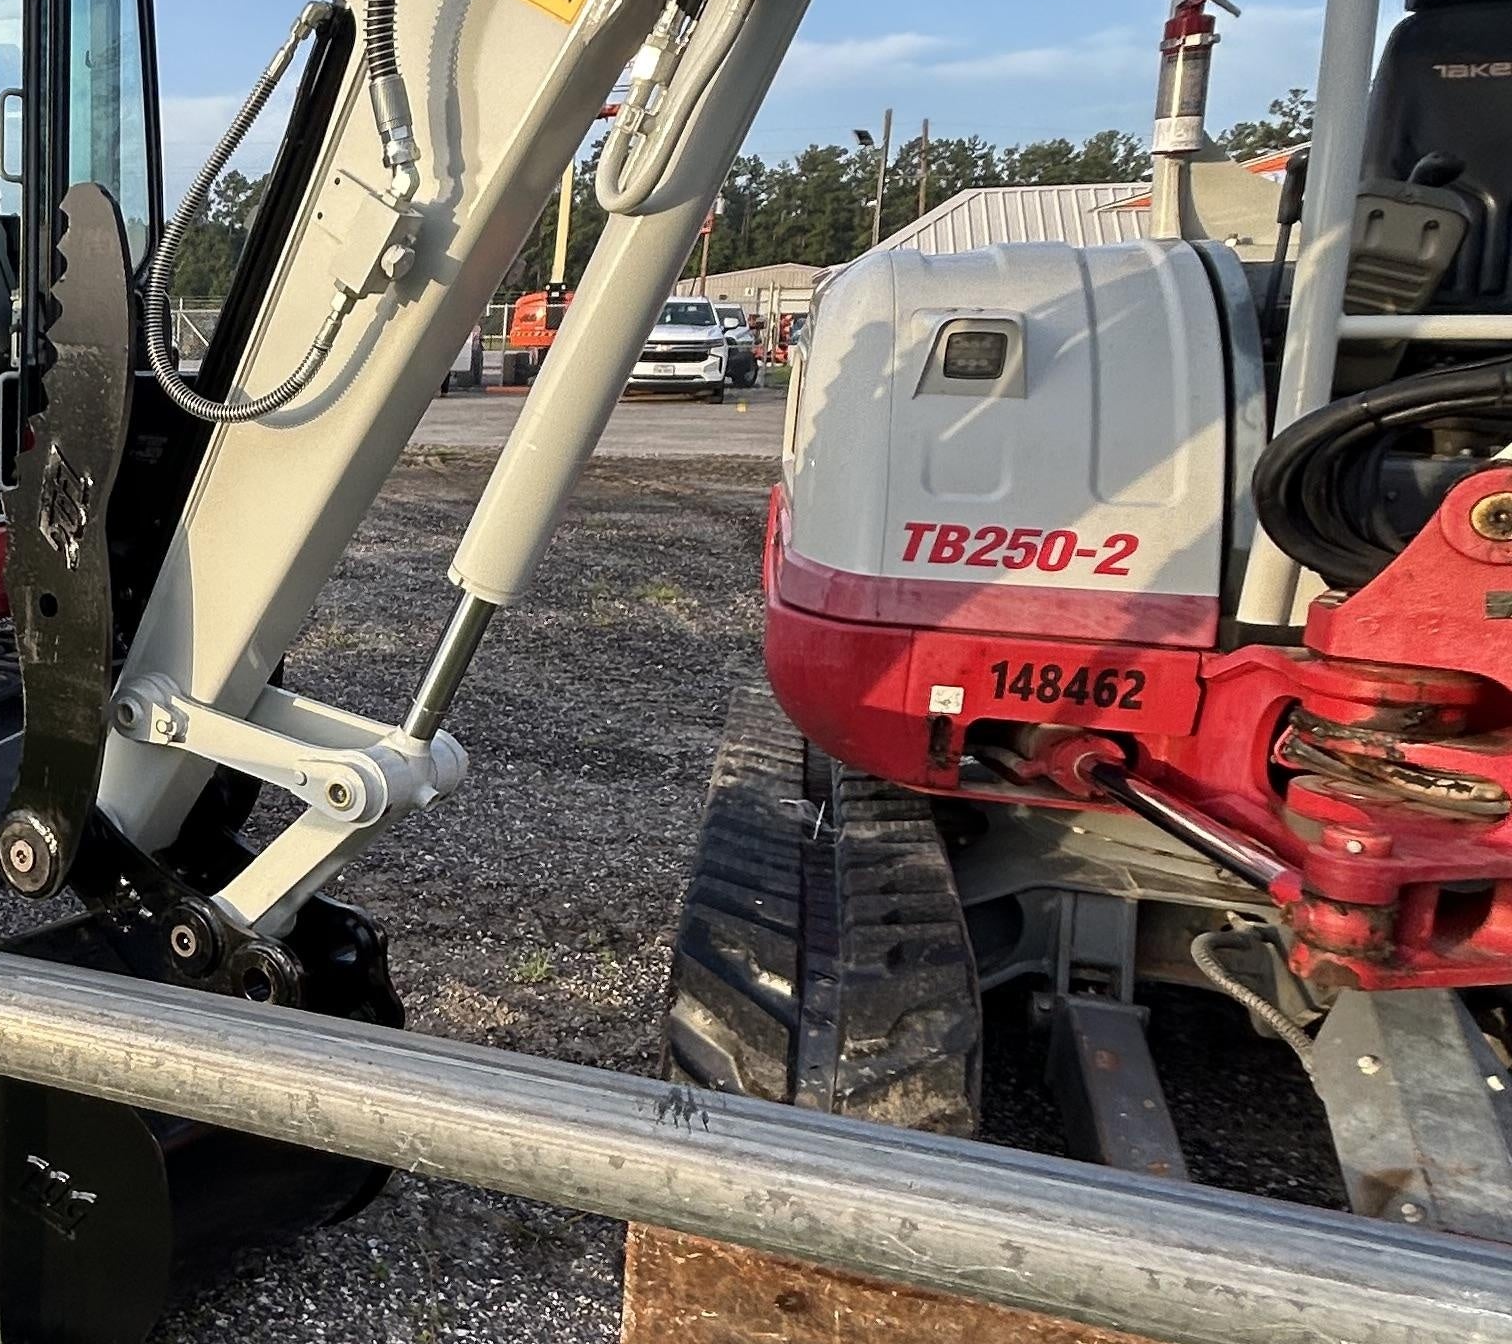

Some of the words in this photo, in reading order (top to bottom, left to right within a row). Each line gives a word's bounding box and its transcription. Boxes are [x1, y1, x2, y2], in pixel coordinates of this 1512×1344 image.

[1432, 62, 1512, 78] TAKE
[902, 522, 1139, 576] TB250-2
[991, 660, 1146, 710] 148462
